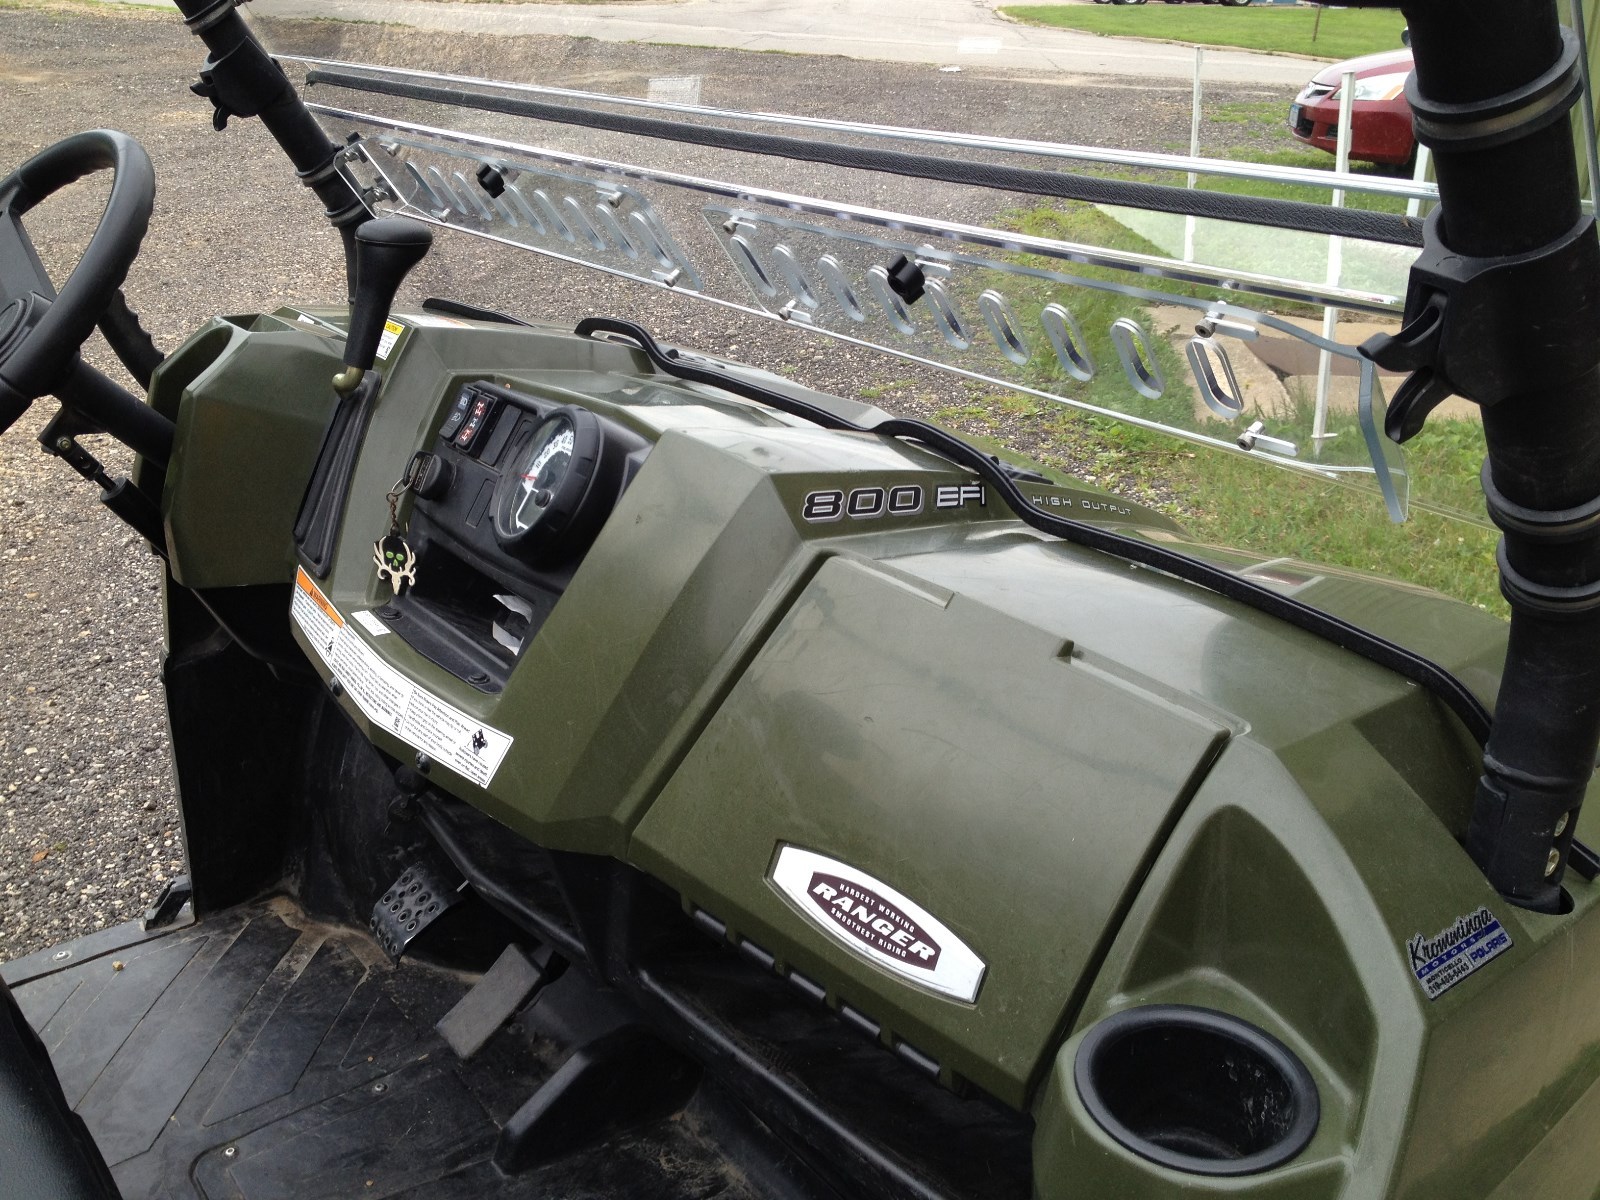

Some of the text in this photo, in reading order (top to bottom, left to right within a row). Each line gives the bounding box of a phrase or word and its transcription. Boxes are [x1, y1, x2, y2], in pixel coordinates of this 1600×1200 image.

[802, 485, 925, 523] 800
[1032, 494, 1133, 516] HIGH OUTPUT
[812, 882, 936, 961] RANGER
[839, 883, 916, 933] HARDEST WORKING
[830, 907, 907, 958] SMOOTHEST RIDING
[1470, 932, 1508, 962] POLARIS
[1421, 938, 1476, 975] MOTORS
